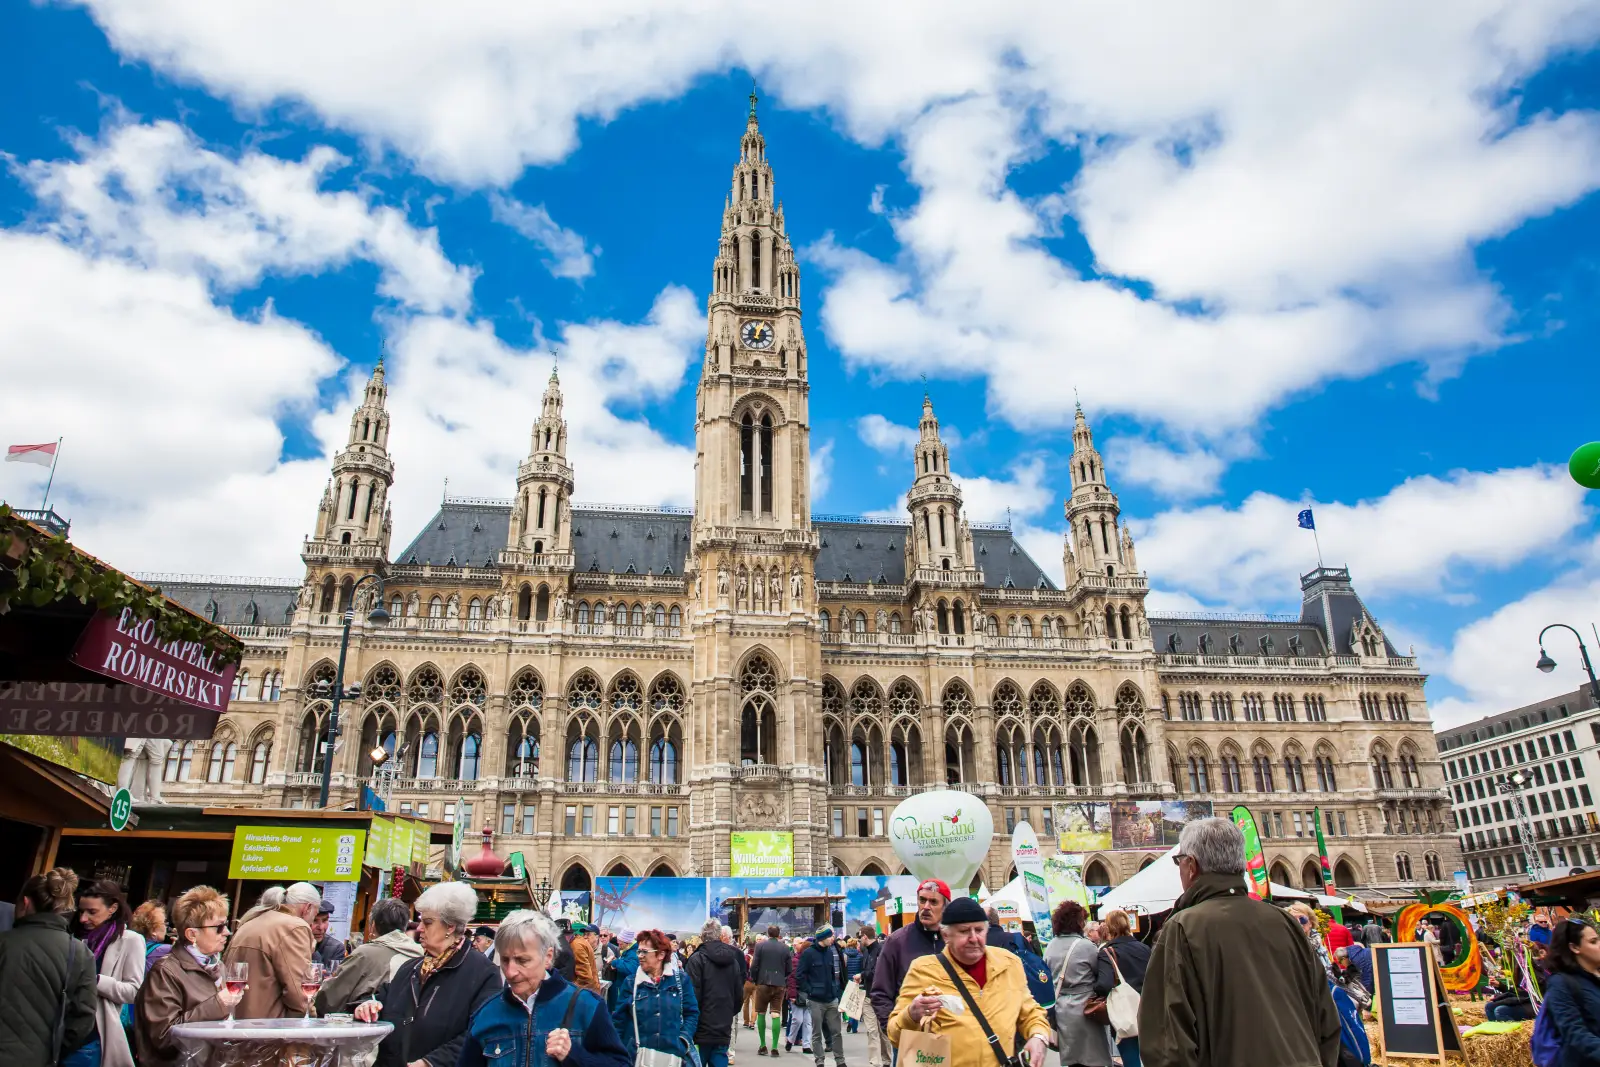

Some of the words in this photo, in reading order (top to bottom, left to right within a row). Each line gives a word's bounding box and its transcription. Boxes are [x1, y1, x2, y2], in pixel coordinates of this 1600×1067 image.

[102, 641, 224, 707] RÖMERSEKT
[114, 799, 129, 820] 15
[902, 822, 937, 844] Apfel
[940, 818, 976, 838] Land
[917, 835, 975, 846] STUBENBERGSEE
[244, 844, 281, 853] Edelbrände
[242, 854, 263, 862] Liköre
[733, 853, 792, 864] Willkommen
[743, 866, 785, 876] Welcome
